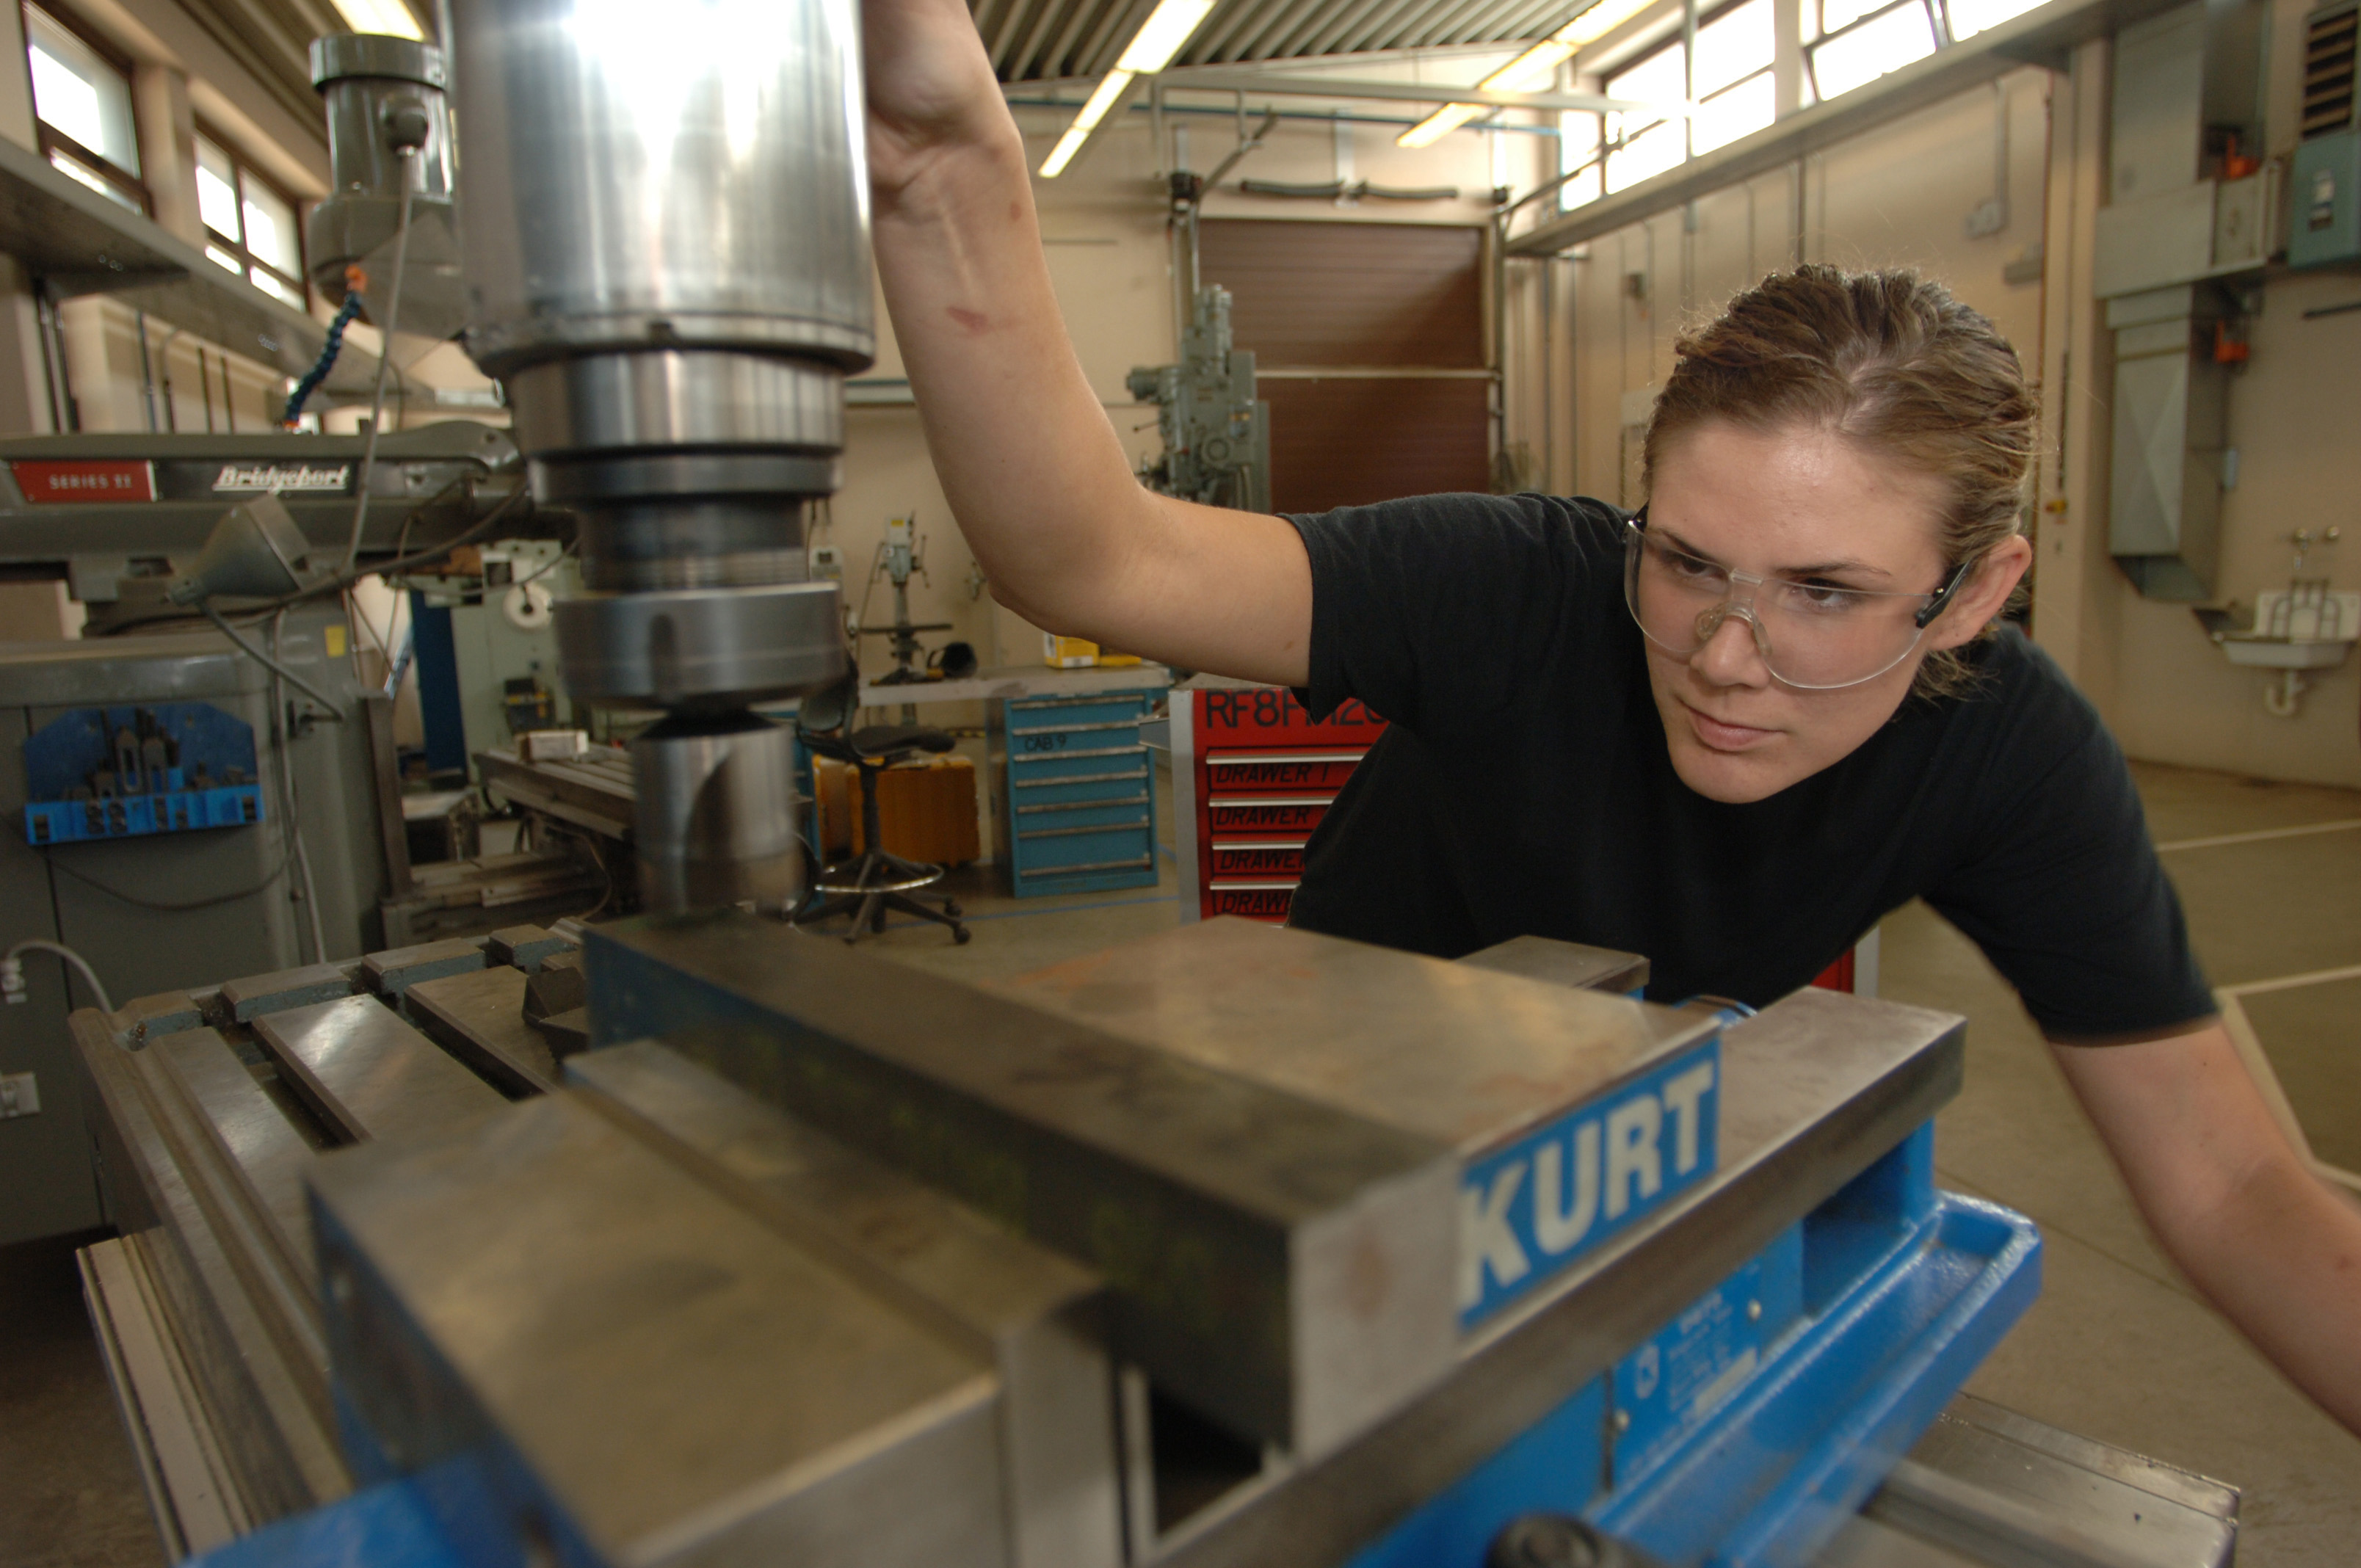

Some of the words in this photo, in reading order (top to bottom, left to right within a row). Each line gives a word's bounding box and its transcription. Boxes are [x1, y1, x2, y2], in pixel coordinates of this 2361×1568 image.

[48, 473, 109, 490] SERIES
[214, 464, 350, 496] Bridgeport
[1216, 762, 1310, 783] DRAWER
[1216, 806, 1311, 826] DRAWER
[1222, 892, 1291, 914] DRAW
[1459, 1059, 1714, 1310] KURT
